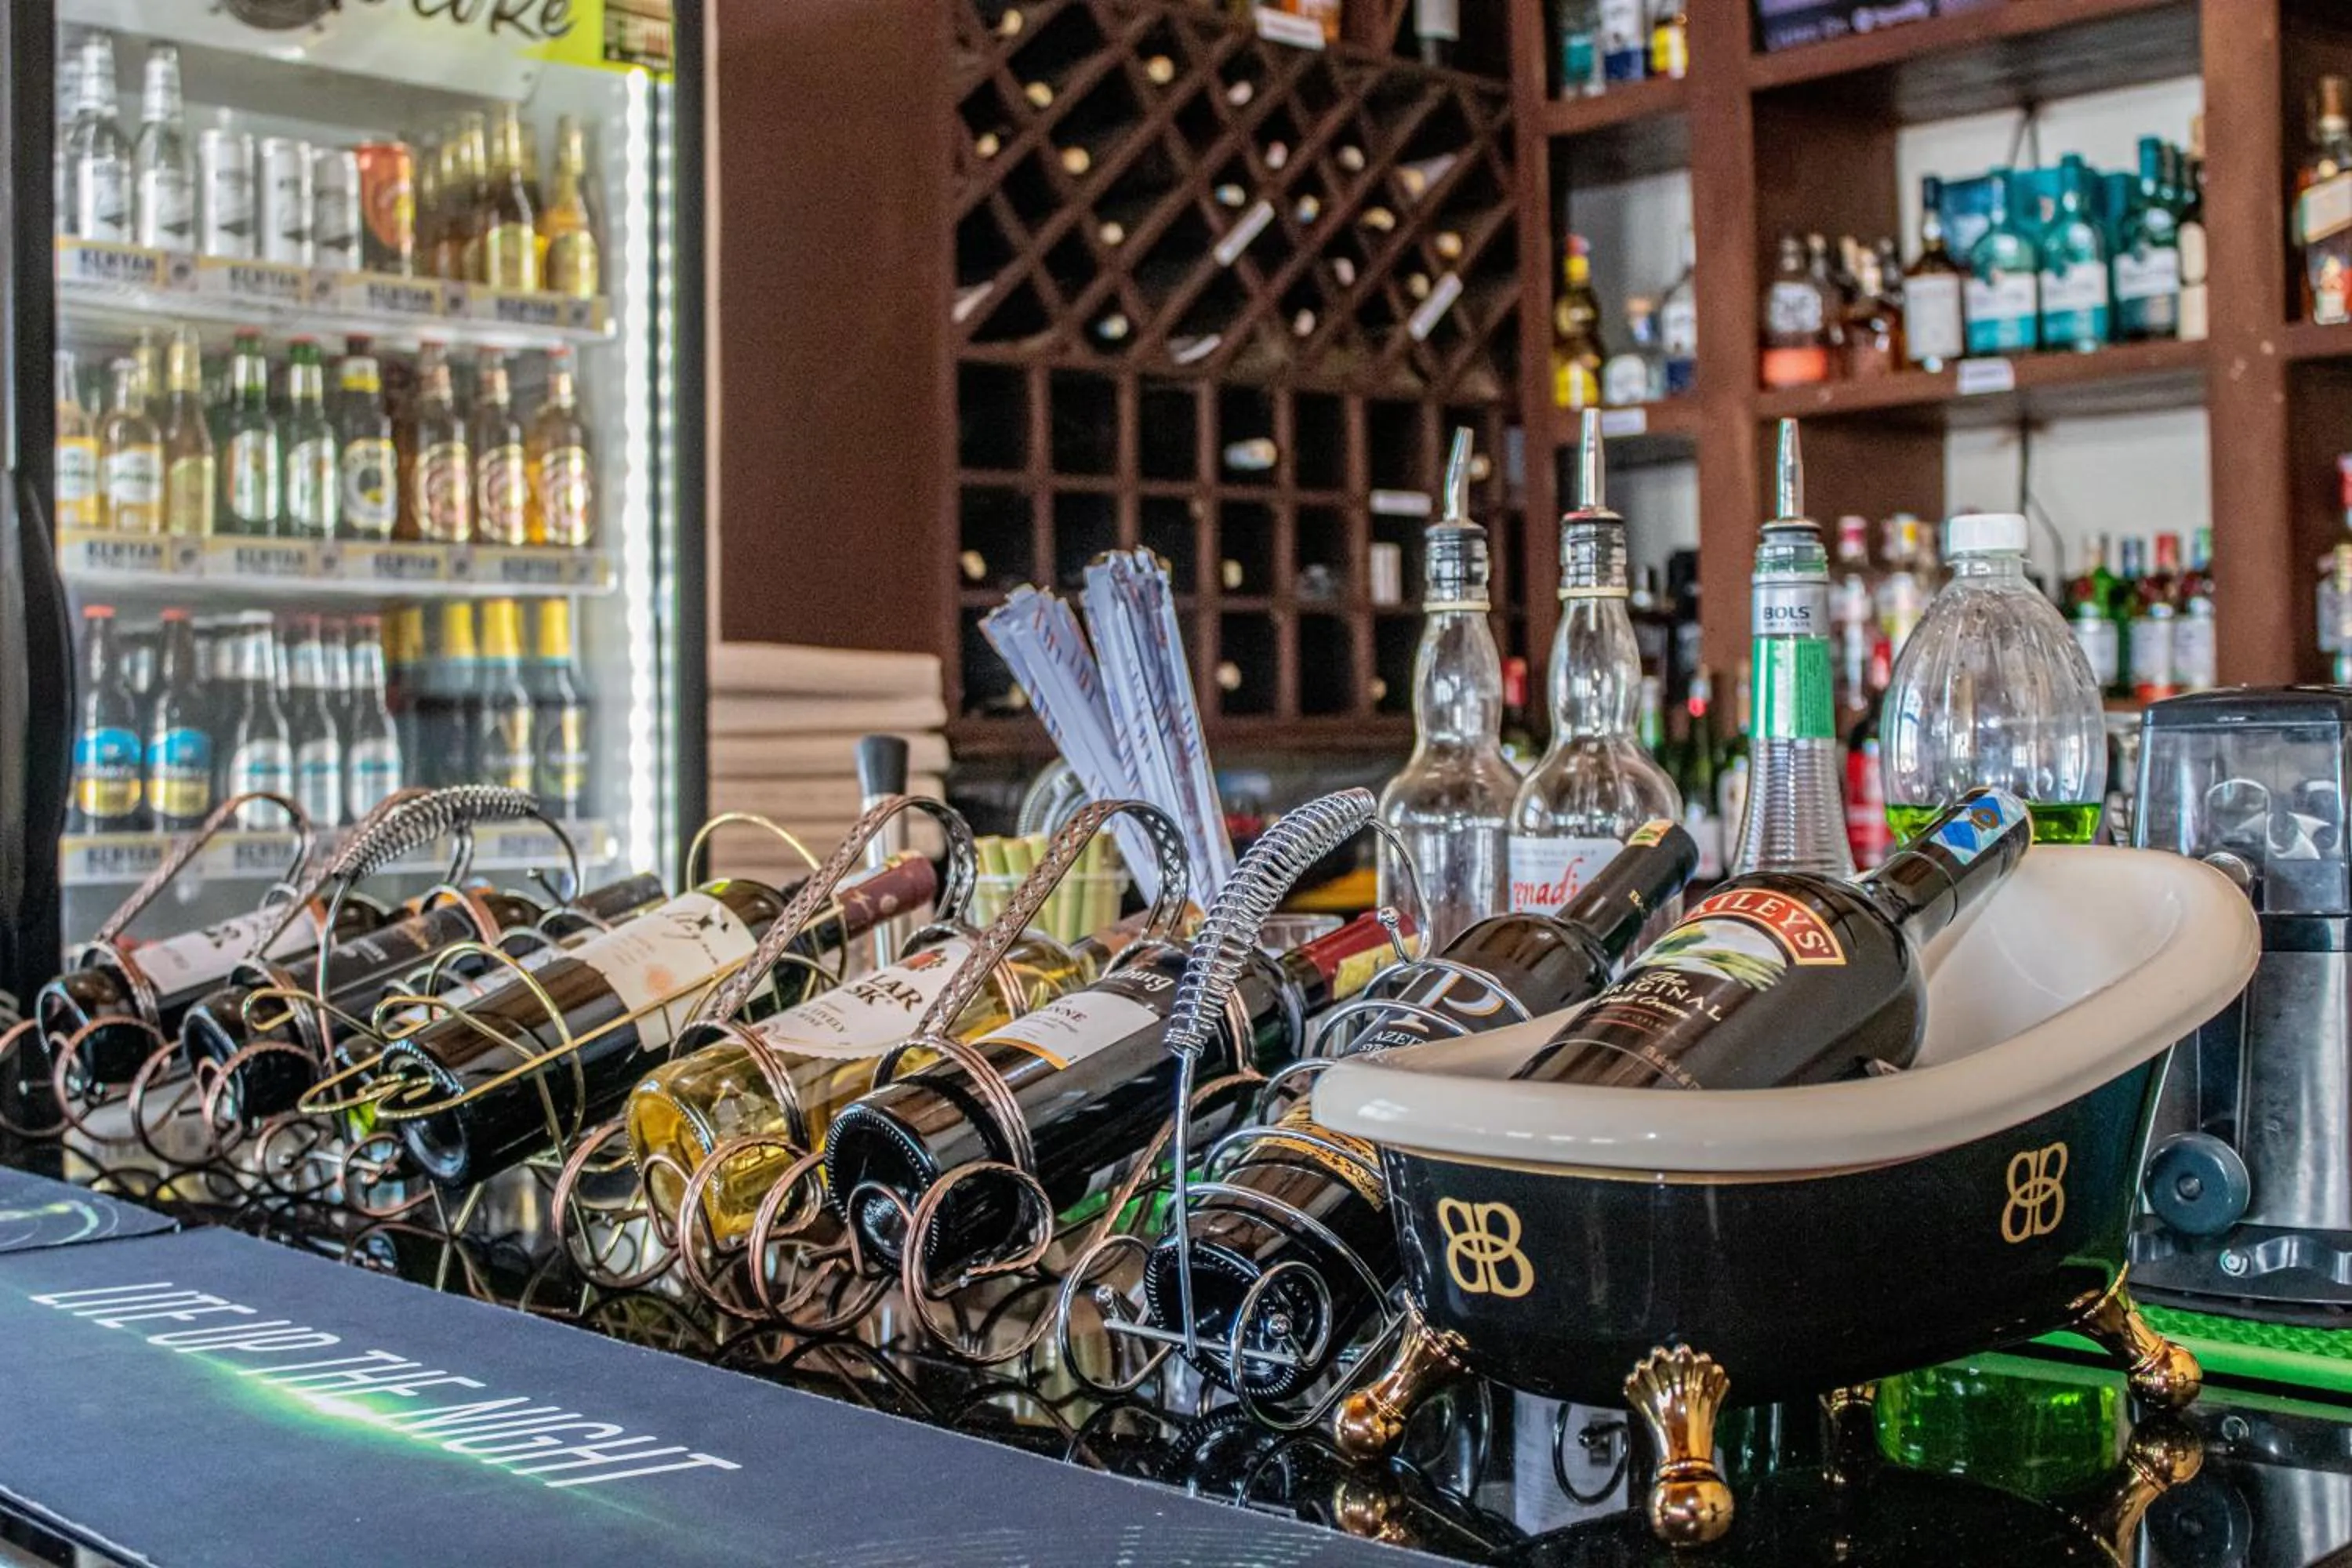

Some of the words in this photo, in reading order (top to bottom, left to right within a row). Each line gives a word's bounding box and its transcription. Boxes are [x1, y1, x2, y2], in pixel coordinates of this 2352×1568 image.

[1763, 606, 1810, 620] BOLS
[867, 975, 923, 1012] LAR
[29, 1281, 257, 1329] LITE
[147, 1319, 341, 1353] UP
[236, 1348, 486, 1401] THE
[375, 1396, 742, 1489] NIGHT
